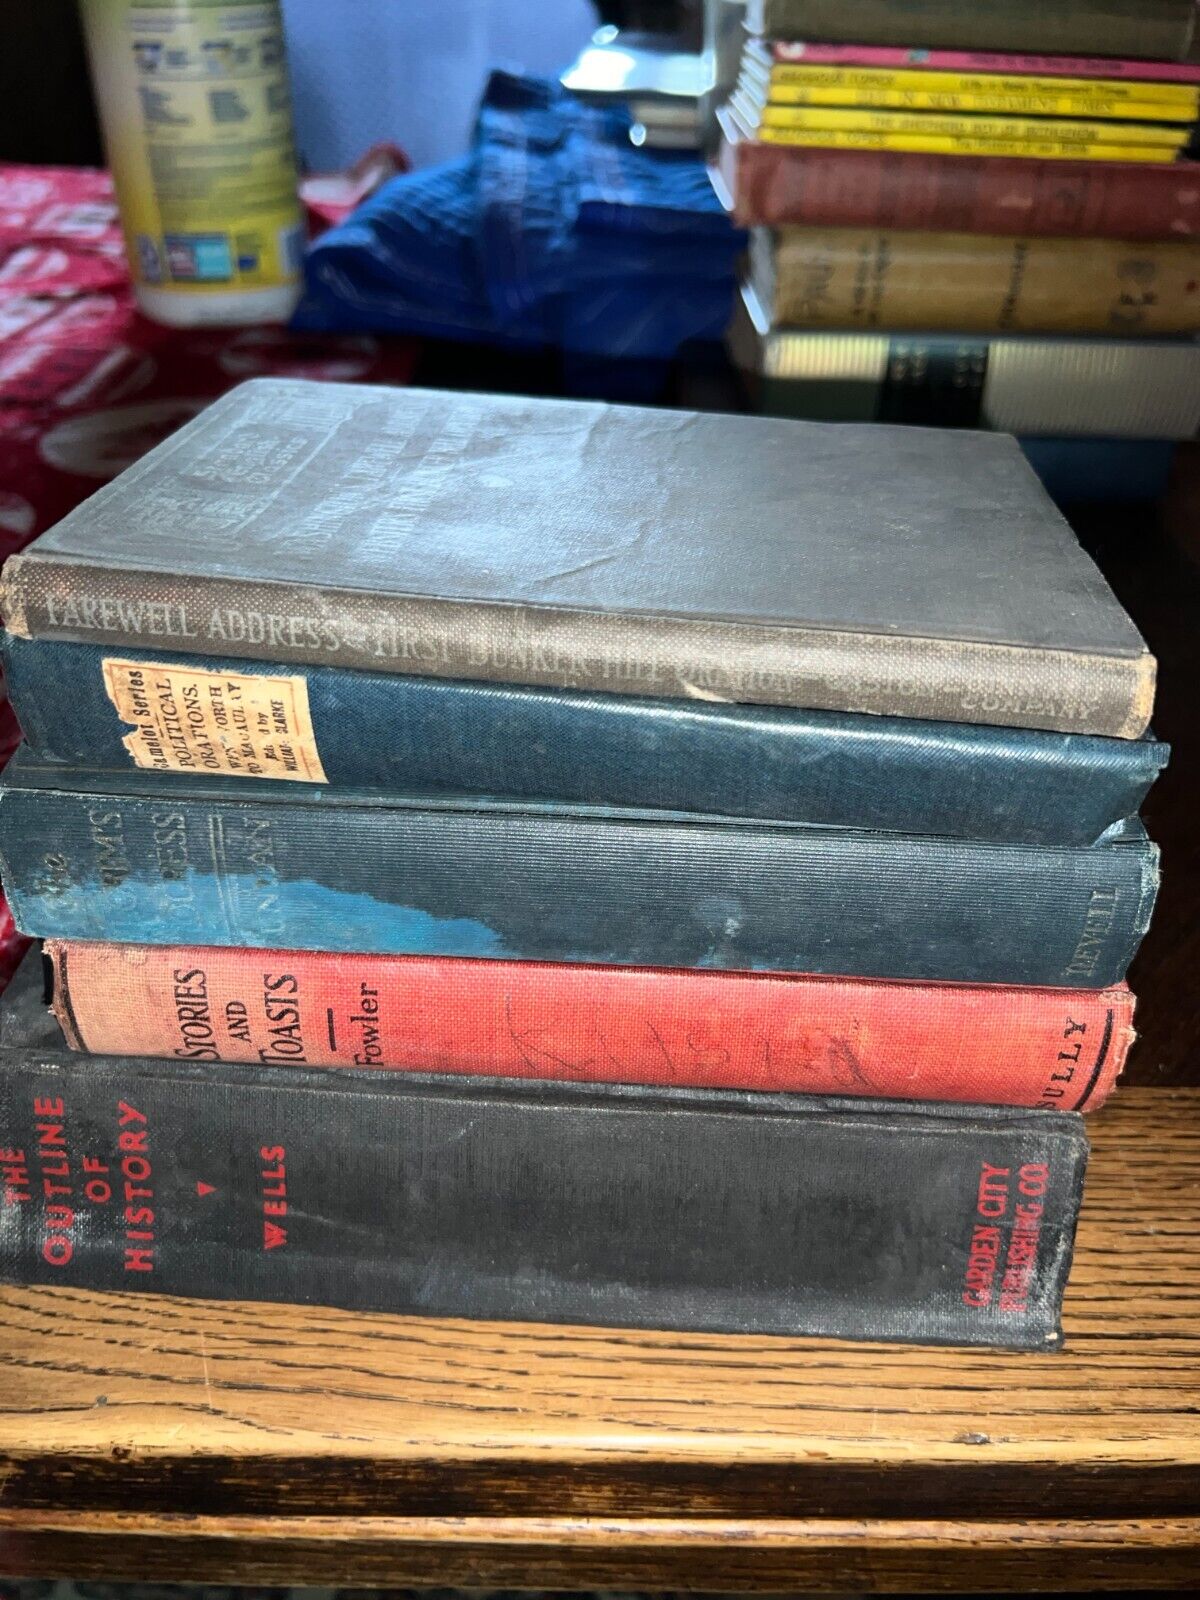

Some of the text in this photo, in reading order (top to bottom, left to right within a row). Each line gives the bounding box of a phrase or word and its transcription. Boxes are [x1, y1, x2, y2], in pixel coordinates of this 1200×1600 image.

[45, 595, 201, 639] FAREWELL
[207, 608, 340, 652] ADDRESS
[129, 670, 151, 717] Series
[156, 677, 196, 768] POLITICAL
[182, 682, 220, 769] ORATIONS.
[257, 711, 271, 724] by
[173, 968, 220, 1060] STORIES
[226, 1000, 251, 1043] AND
[258, 973, 307, 1063] TOASTS
[350, 982, 385, 1067] Fowler
[0, 1147, 32, 1206] THE
[34, 1096, 75, 1266] OUTLINE
[83, 1155, 112, 1204] OF
[117, 1100, 155, 1271] HISTORY
[260, 1145, 288, 1251] WELLS
[961, 1161, 1011, 1307] GARDEN CITY
